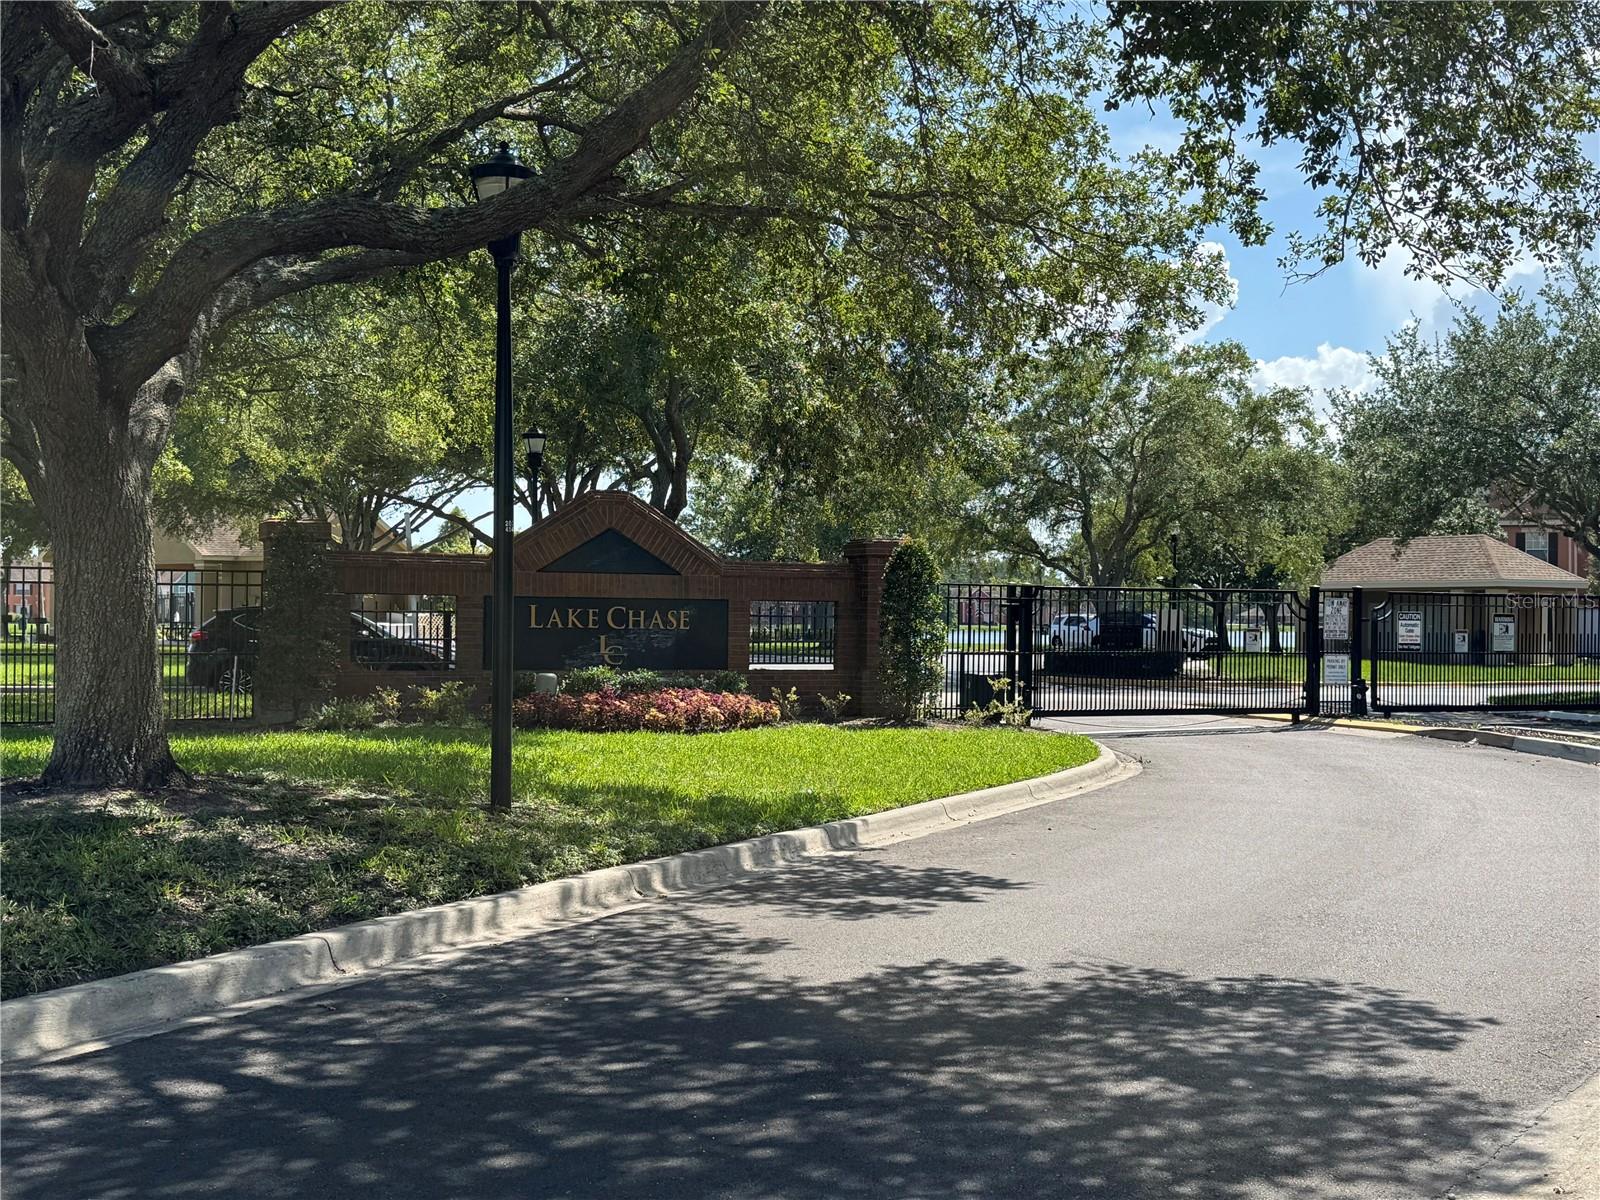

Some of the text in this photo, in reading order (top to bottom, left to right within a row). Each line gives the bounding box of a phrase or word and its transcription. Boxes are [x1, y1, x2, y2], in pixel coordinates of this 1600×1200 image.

[528, 604, 690, 630] LAKE CHASE
[1330, 606, 1342, 615] ZONE
